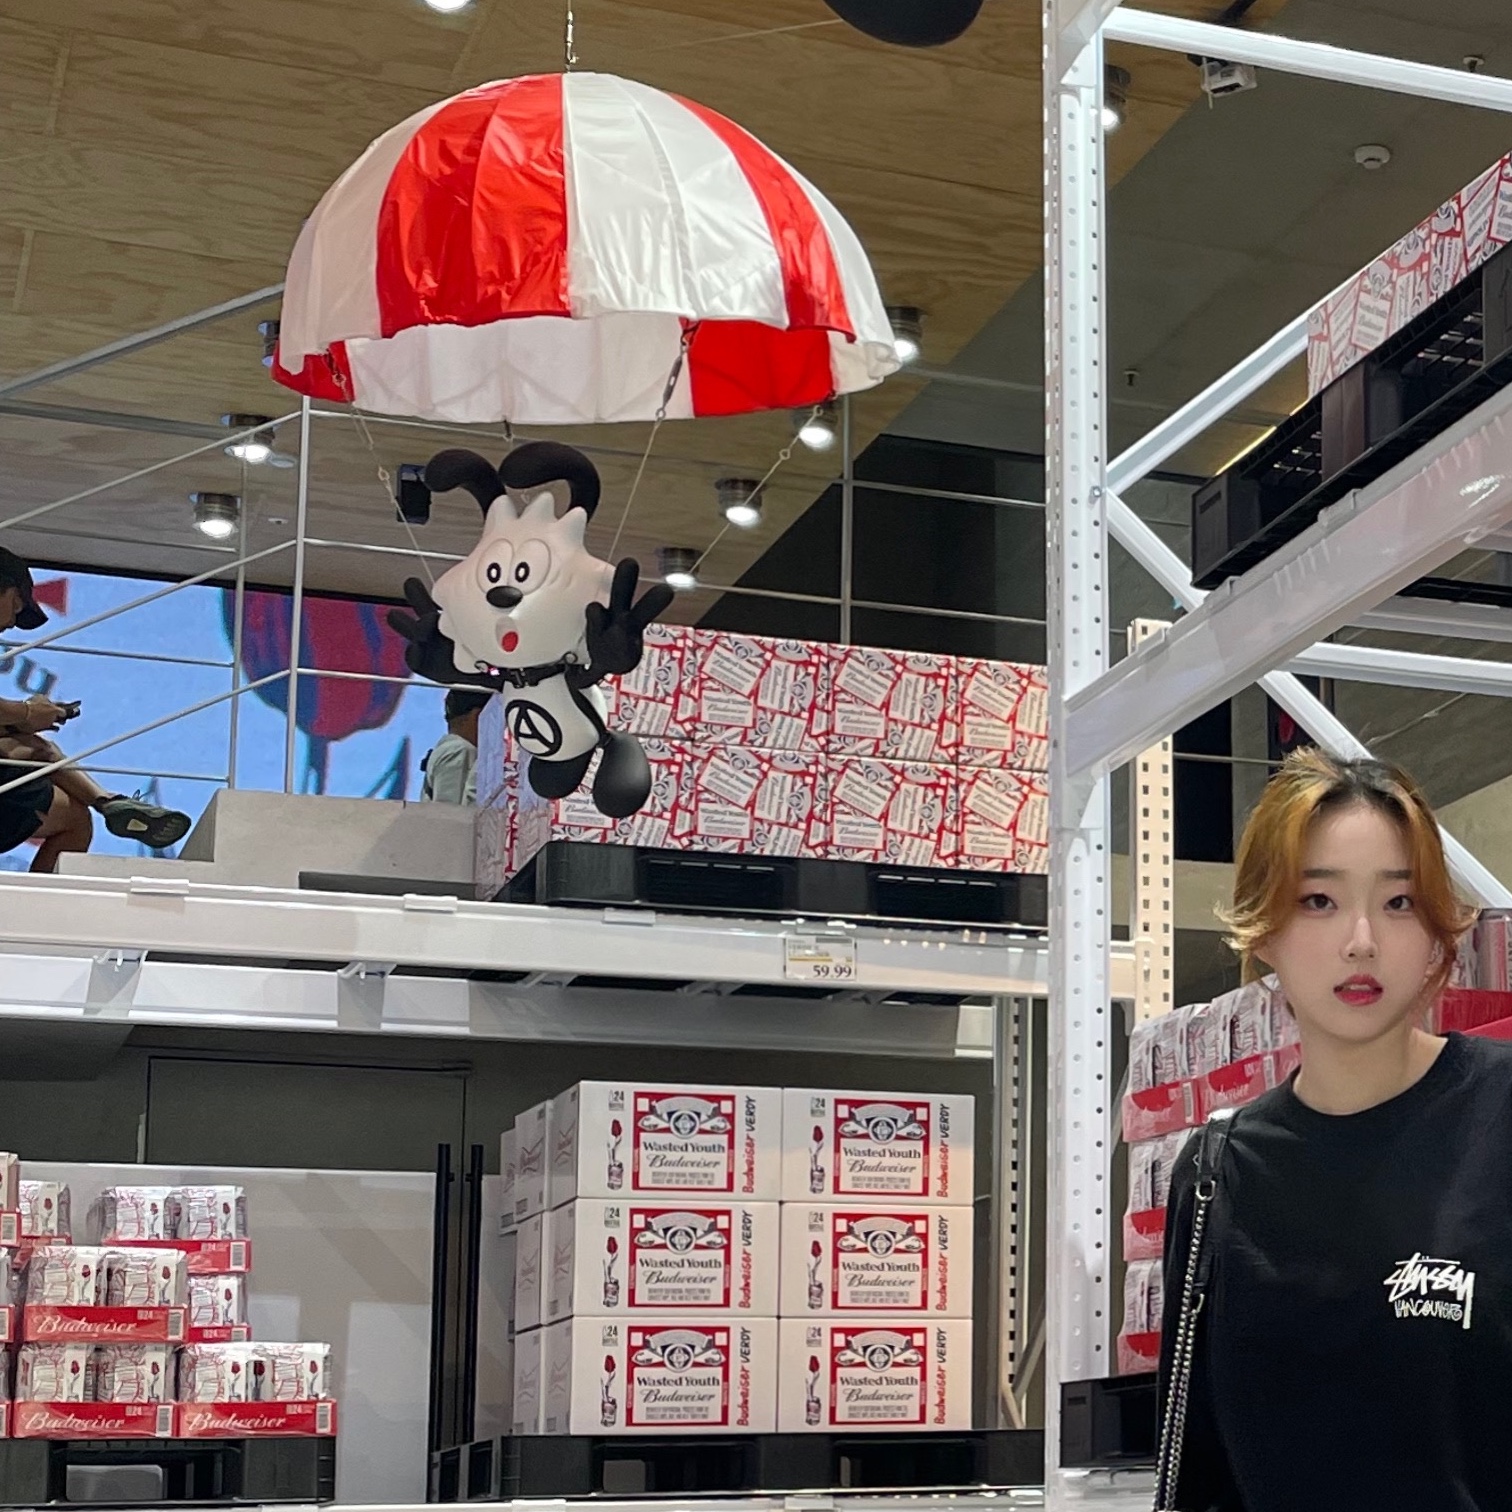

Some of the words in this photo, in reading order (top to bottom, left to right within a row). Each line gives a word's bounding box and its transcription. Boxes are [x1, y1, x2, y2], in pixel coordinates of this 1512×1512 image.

[813, 965, 852, 977] 59.99
[746, 1096, 756, 1132] VERDY
[940, 1104, 950, 1138] VERDY
[643, 1142, 689, 1152] Wasted
[689, 1143, 725, 1153] Youth
[843, 1147, 887, 1157] Wasted
[887, 1149, 921, 1159] Youth
[646, 1155, 720, 1168] Budweiser
[742, 1135, 755, 1193] Budweiser
[847, 1159, 916, 1173] Budweiser
[937, 1141, 949, 1197] Budweiser
[743, 1210, 753, 1246] VERDY
[939, 1215, 949, 1250] VERDY
[640, 1258, 686, 1268] Wasted
[686, 1258, 722, 1269] Youth
[842, 1262, 885, 1271] Wasted
[886, 1262, 919, 1272] Youth
[643, 1270, 717, 1284] Budweiser
[738, 1249, 752, 1308] Budweiser
[845, 1274, 915, 1287] Budweiser
[936, 1253, 948, 1311] Budweiser
[34, 1312, 136, 1334] Budweiser
[741, 1327, 751, 1363] VERDY
[937, 1328, 947, 1363] VERDY
[637, 1376, 683, 1386] Wasted
[684, 1376, 720, 1387] Youth
[840, 1376, 884, 1386] Wasted
[884, 1376, 918, 1386] Youth
[640, 1389, 715, 1403] Budweiser
[737, 1367, 750, 1426] Budweiser
[843, 1388, 914, 1402] Budweiser
[934, 1366, 946, 1424] Budweiser
[22, 1412, 125, 1431] Budweiser
[182, 1411, 286, 1430] Budweiser
